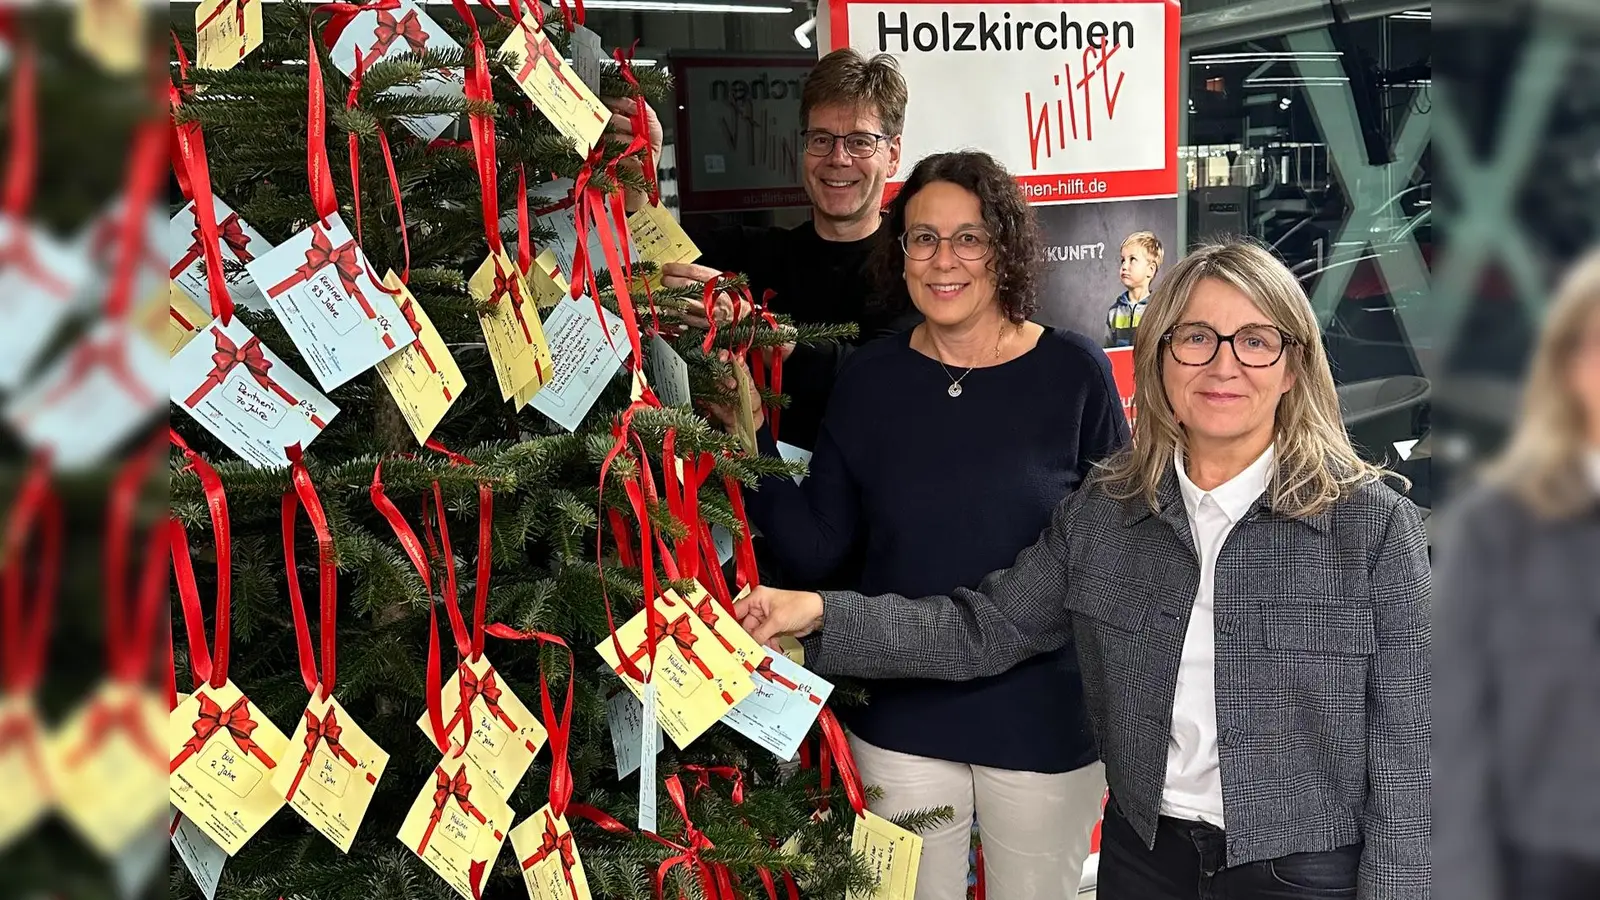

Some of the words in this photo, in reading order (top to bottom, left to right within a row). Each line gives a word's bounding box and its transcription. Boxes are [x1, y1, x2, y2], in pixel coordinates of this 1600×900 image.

[878, 11, 1134, 52] Holzkirchen
[1025, 36, 1125, 170] hilft
[1045, 242, 1105, 262] KUNFT?
[319, 275, 343, 303] Rentner
[321, 297, 340, 319] Jahre
[237, 381, 278, 414] Rentnerin
[244, 404, 268, 422] Jahre
